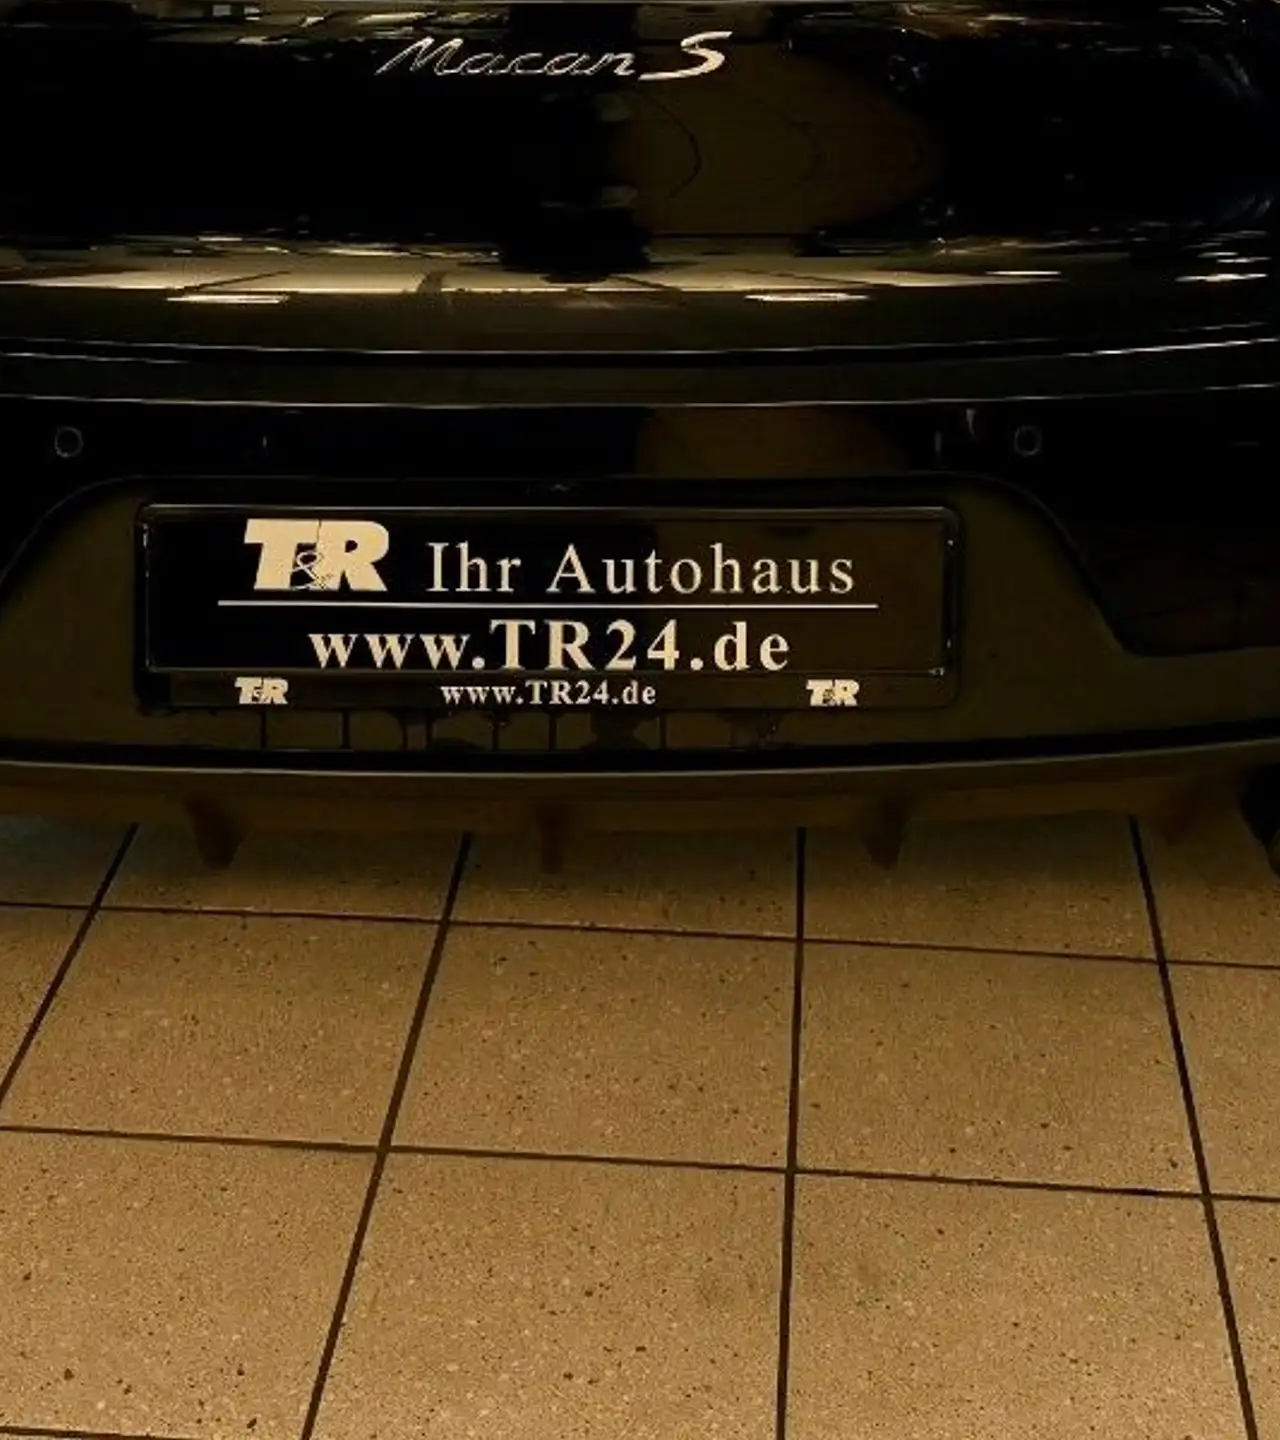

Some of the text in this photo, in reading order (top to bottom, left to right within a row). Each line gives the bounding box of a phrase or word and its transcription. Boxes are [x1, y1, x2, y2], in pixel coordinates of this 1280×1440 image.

[374, 30, 733, 80] Macan S
[428, 541, 522, 592] Ihr
[547, 542, 854, 594] Autohaus
[309, 618, 790, 671] www.TR24.de
[440, 679, 656, 705] www.TR24.de
